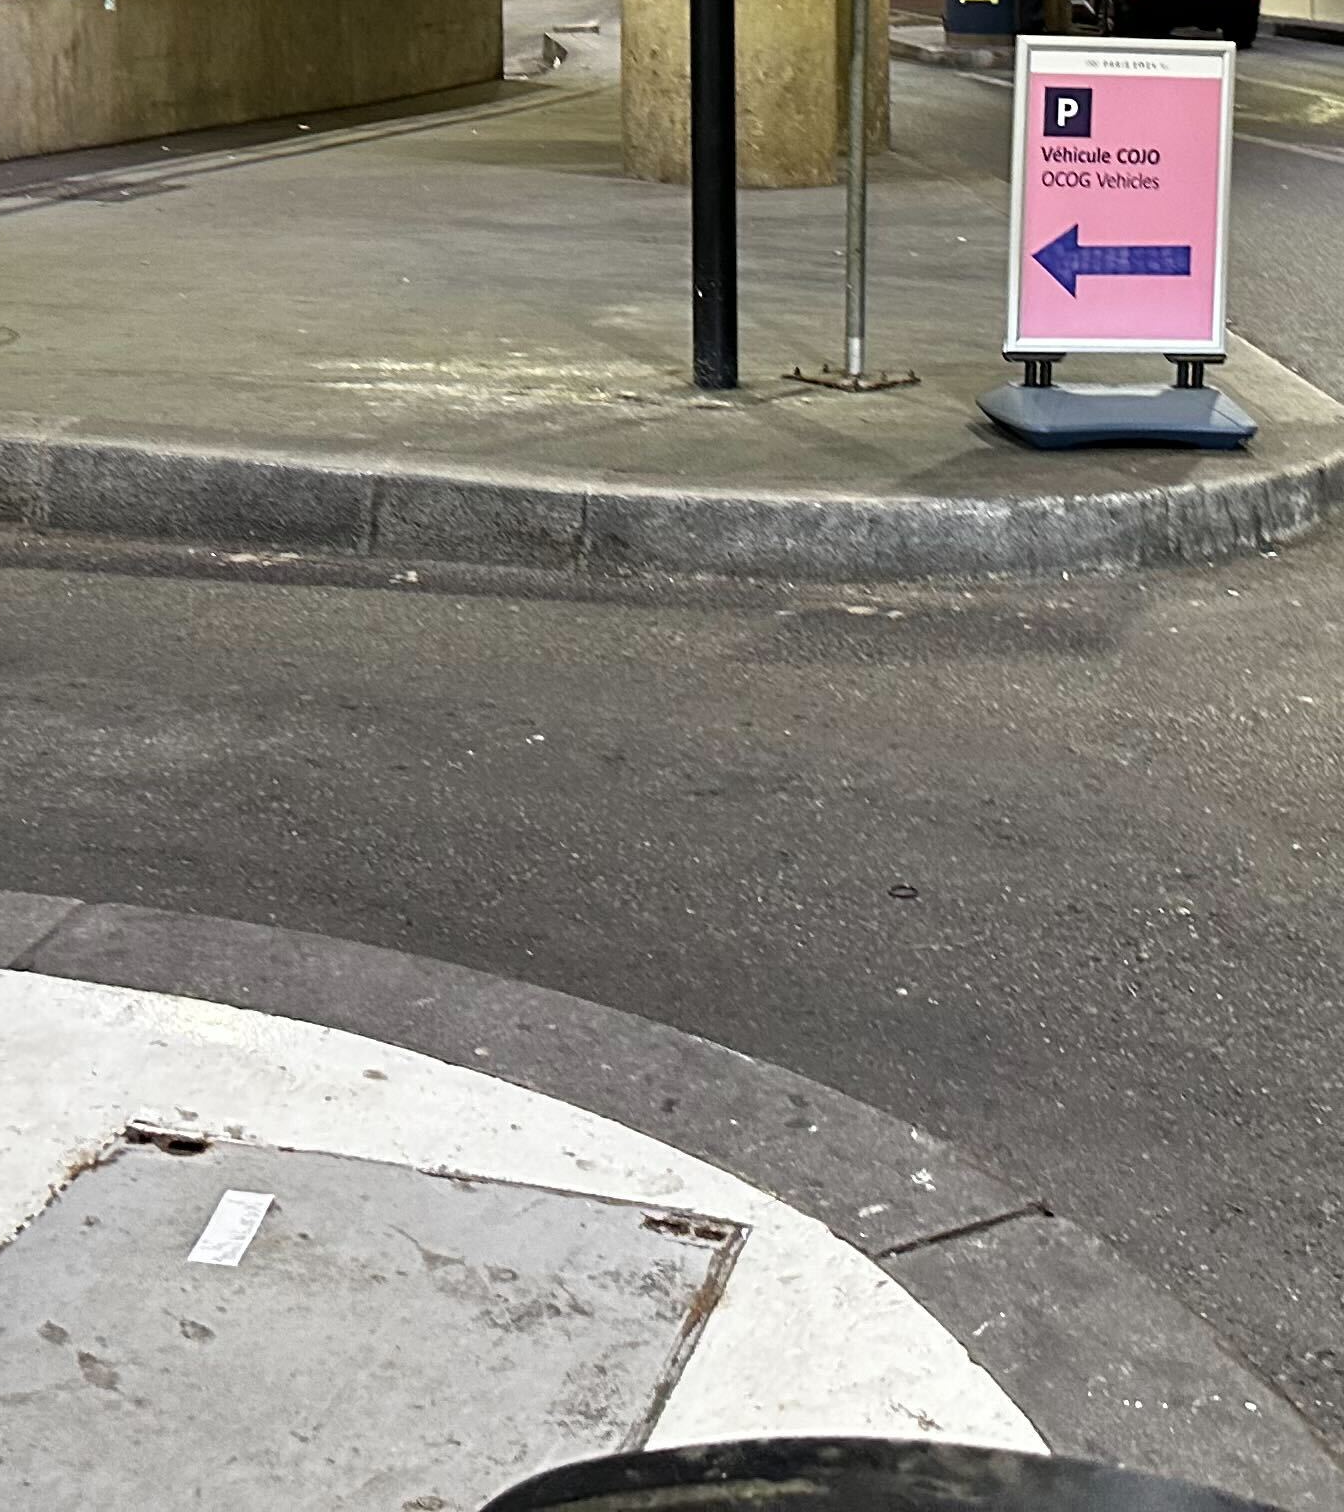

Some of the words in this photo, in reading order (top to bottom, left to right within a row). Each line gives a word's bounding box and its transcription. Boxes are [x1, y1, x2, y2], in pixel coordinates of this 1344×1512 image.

[1057, 97, 1079, 127] P
[1041, 146, 1111, 164] Véhicule
[1117, 148, 1161, 165] COJO
[1041, 170, 1092, 188] OCOG
[1096, 171, 1160, 189] Vehicles
